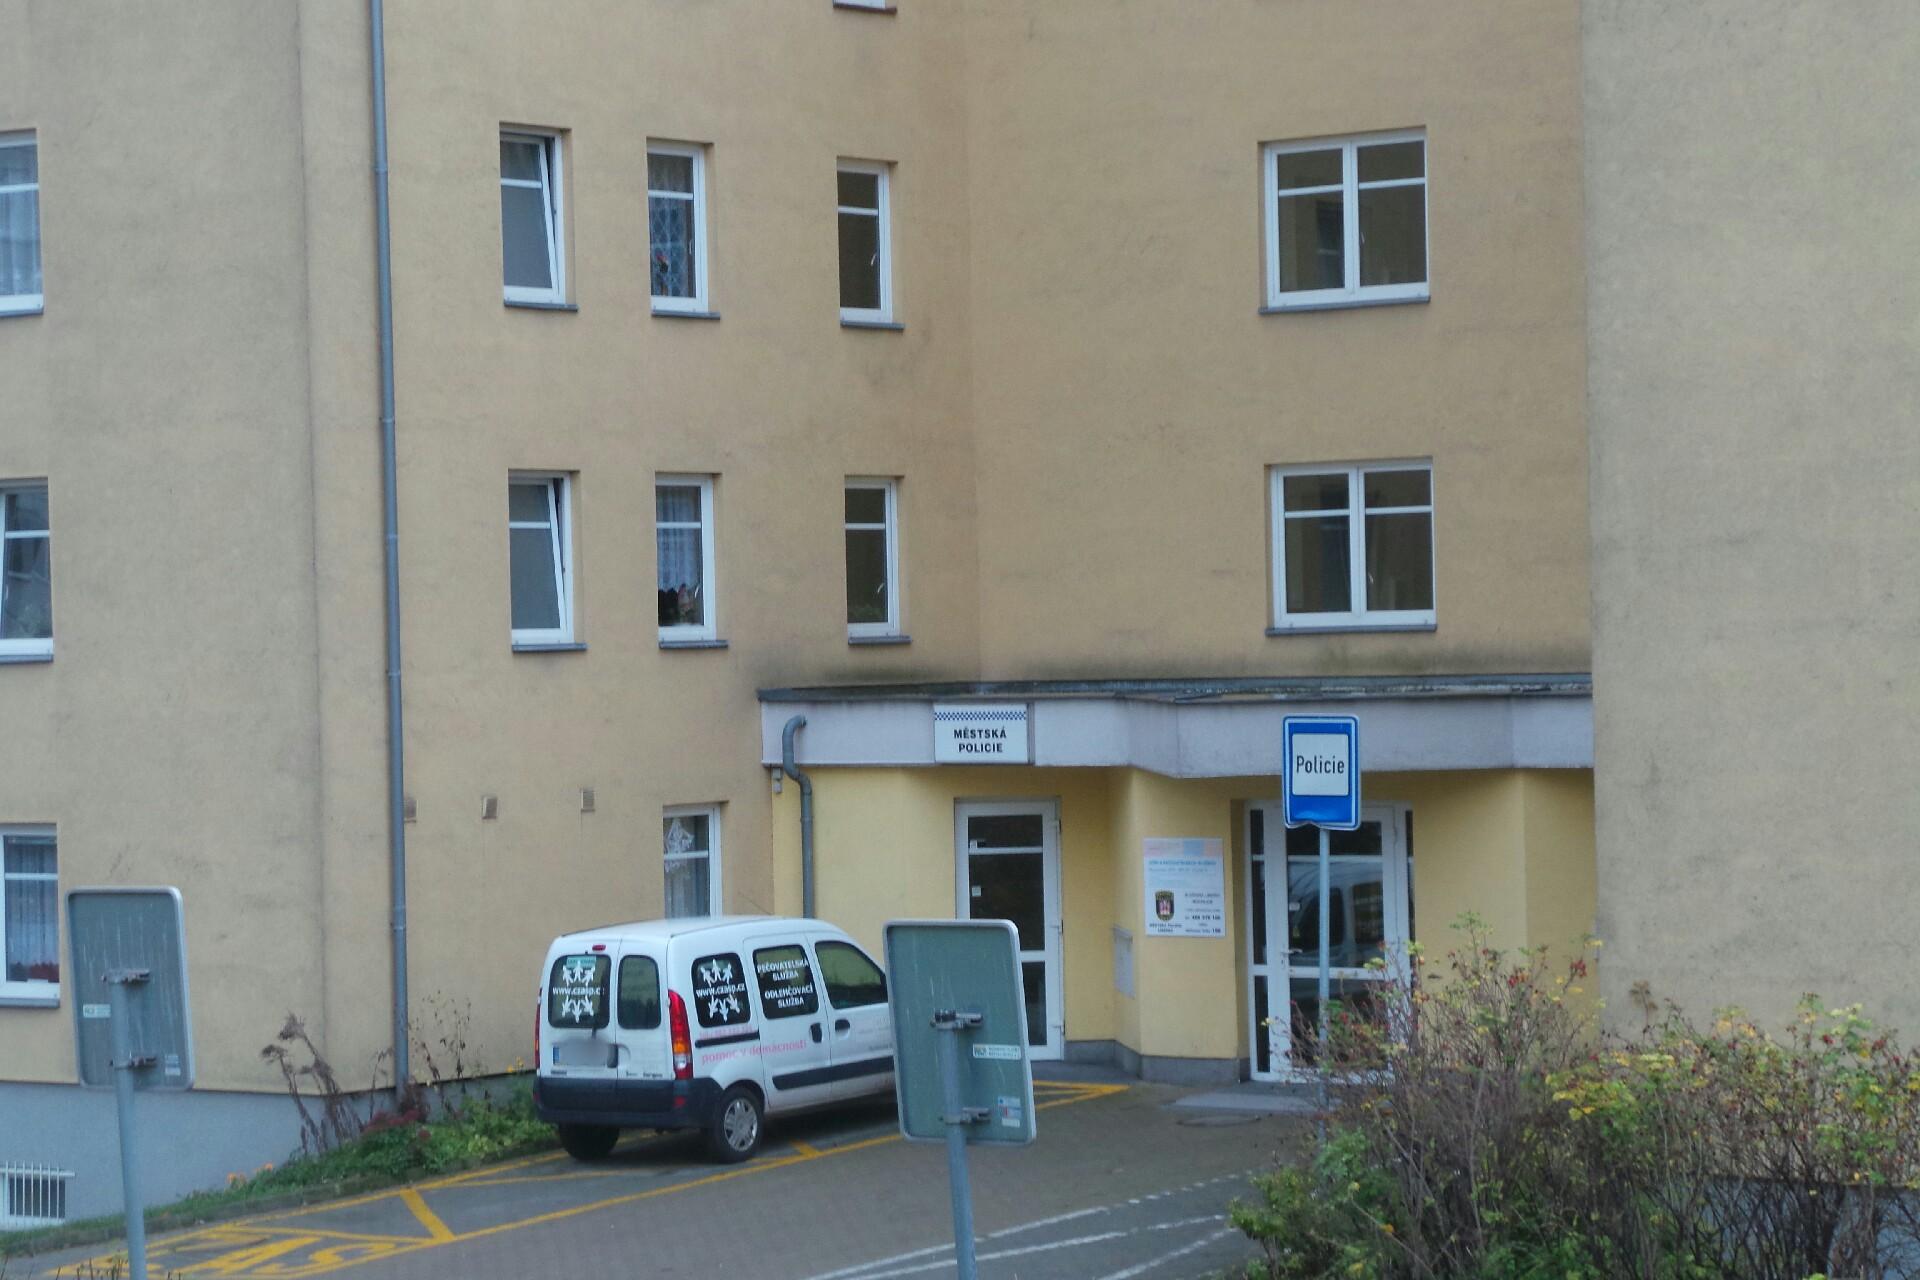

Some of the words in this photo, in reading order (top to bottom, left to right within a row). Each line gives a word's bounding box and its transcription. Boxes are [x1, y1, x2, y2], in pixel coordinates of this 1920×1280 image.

[953, 725, 1007, 739] MĚSTSKÁ
[958, 743, 1004, 753] POLICIE
[1296, 755, 1345, 774] Policie
